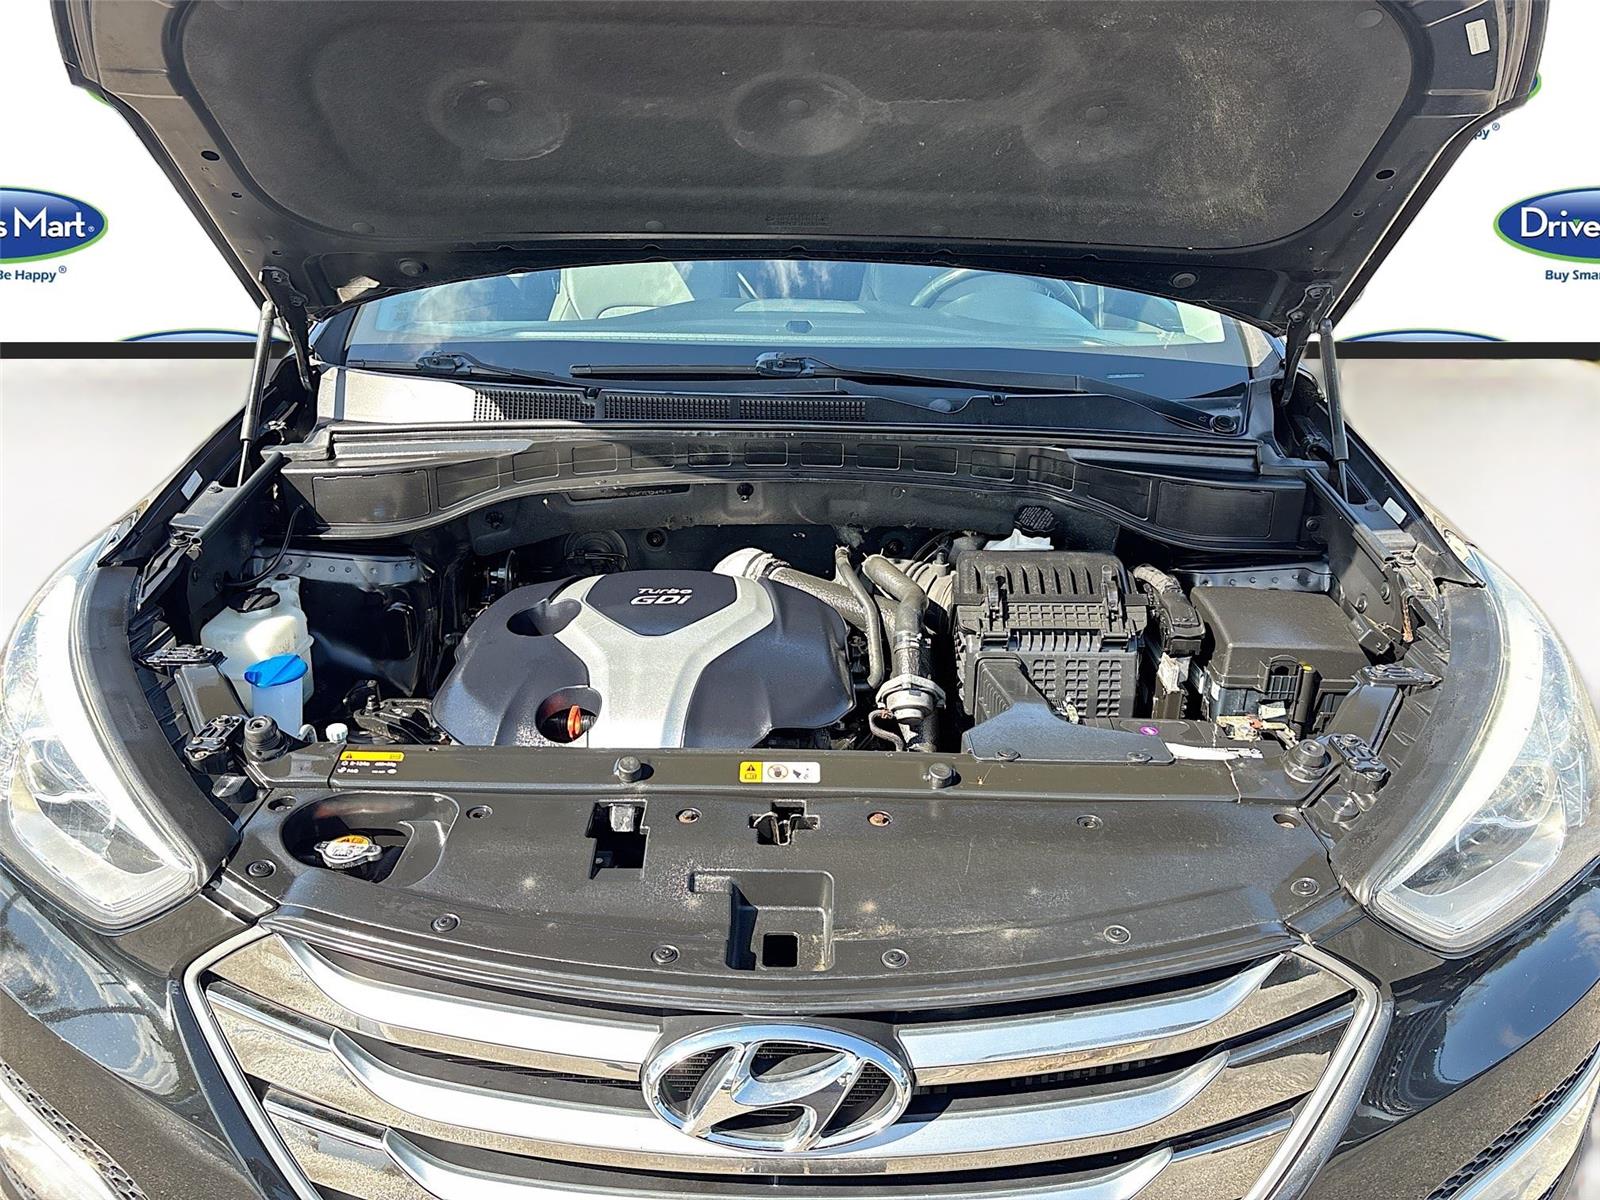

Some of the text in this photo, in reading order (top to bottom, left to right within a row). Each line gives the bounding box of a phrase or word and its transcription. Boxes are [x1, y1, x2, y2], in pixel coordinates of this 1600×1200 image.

[13, 206, 86, 238] Mart
[1520, 206, 1600, 238] Drive
[1545, 269, 1600, 283] Buy Sma
[630, 595, 692, 605] GDI
